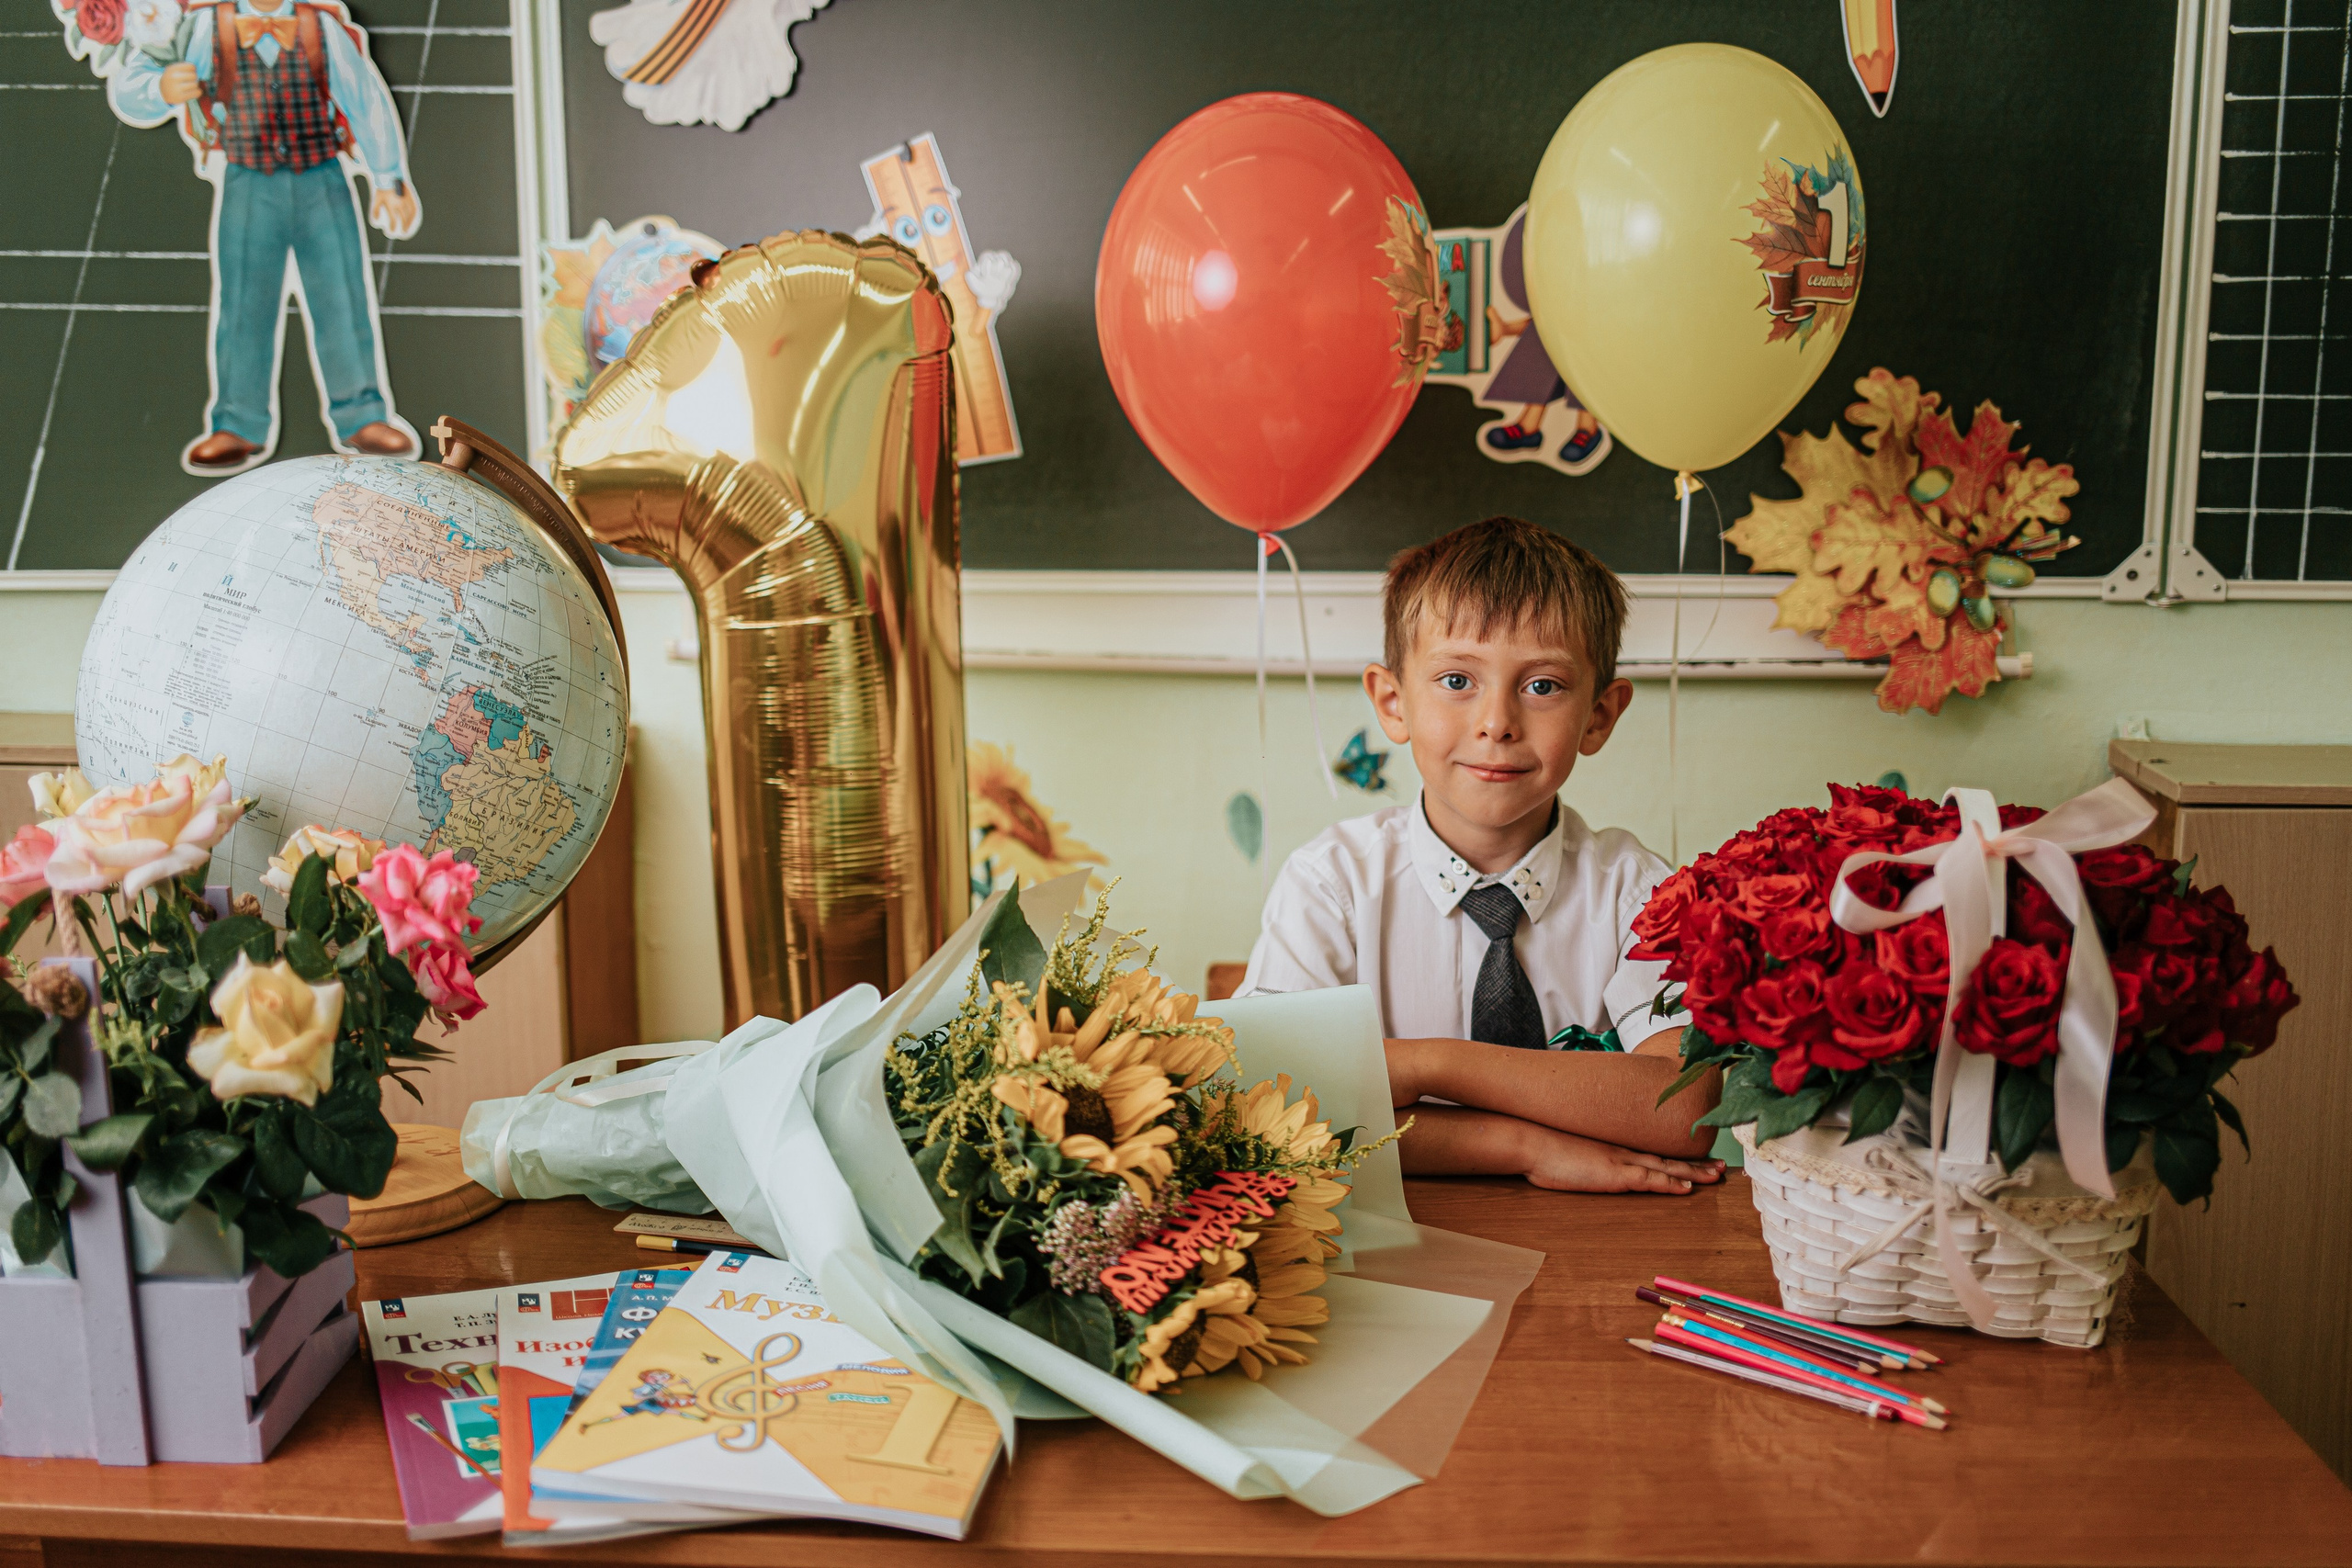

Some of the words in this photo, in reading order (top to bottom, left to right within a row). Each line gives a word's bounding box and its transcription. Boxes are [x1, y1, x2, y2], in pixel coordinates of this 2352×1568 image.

[1817, 181, 1849, 268] 1
[1437, 243, 1465, 274] КА
[354, 525, 390, 543] ШТАТЫ
[399, 542, 446, 563] АМЕРИКИ
[202, 592, 242, 607] политический
[243, 604, 262, 614] глобус
[224, 588, 247, 600] МИР
[472, 592, 510, 611] САРГАССОВО
[512, 609, 528, 618] МОРЕ
[324, 597, 366, 616] МЕКСИКА
[450, 655, 487, 671] КАРИБСКОЕ
[489, 669, 505, 680] МОРЕ
[479, 697, 518, 718] ВЕНЕСУЭЛА
[397, 722, 422, 734] ЭКВАДОР
[455, 720, 488, 736] КОЛУМБИЯ
[424, 785, 448, 797] ПЕРУ
[448, 811, 482, 826] БОЛИВИЯ
[481, 807, 546, 837] БРАЗИЛИЯ
[844, 1382, 955, 1476] 1
